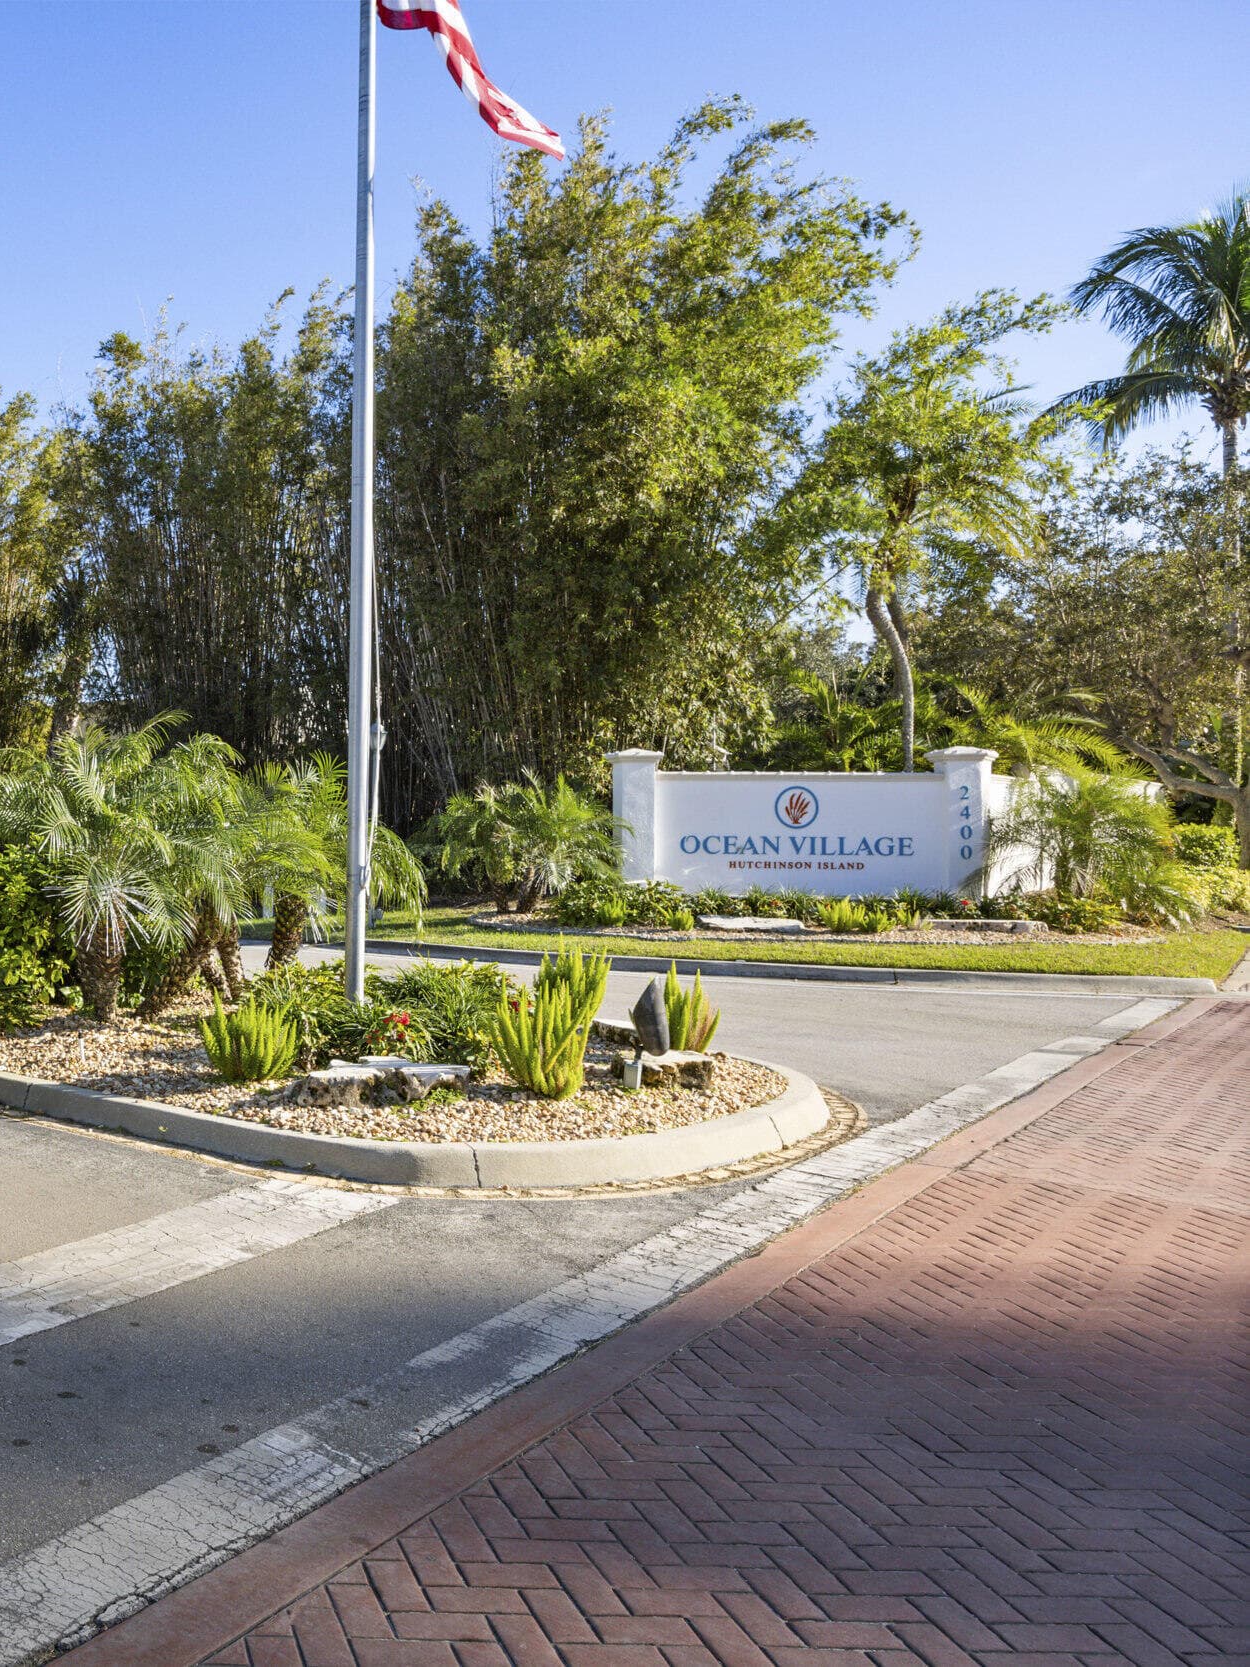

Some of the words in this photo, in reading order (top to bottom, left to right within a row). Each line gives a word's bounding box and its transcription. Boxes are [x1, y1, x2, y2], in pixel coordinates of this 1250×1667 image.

[959, 785, 973, 860] 2400
[679, 834, 781, 855] OCEAN
[788, 835, 915, 857] VILLAGE
[729, 860, 812, 870] HUTCHINSON
[817, 861, 865, 871] ISLAND
